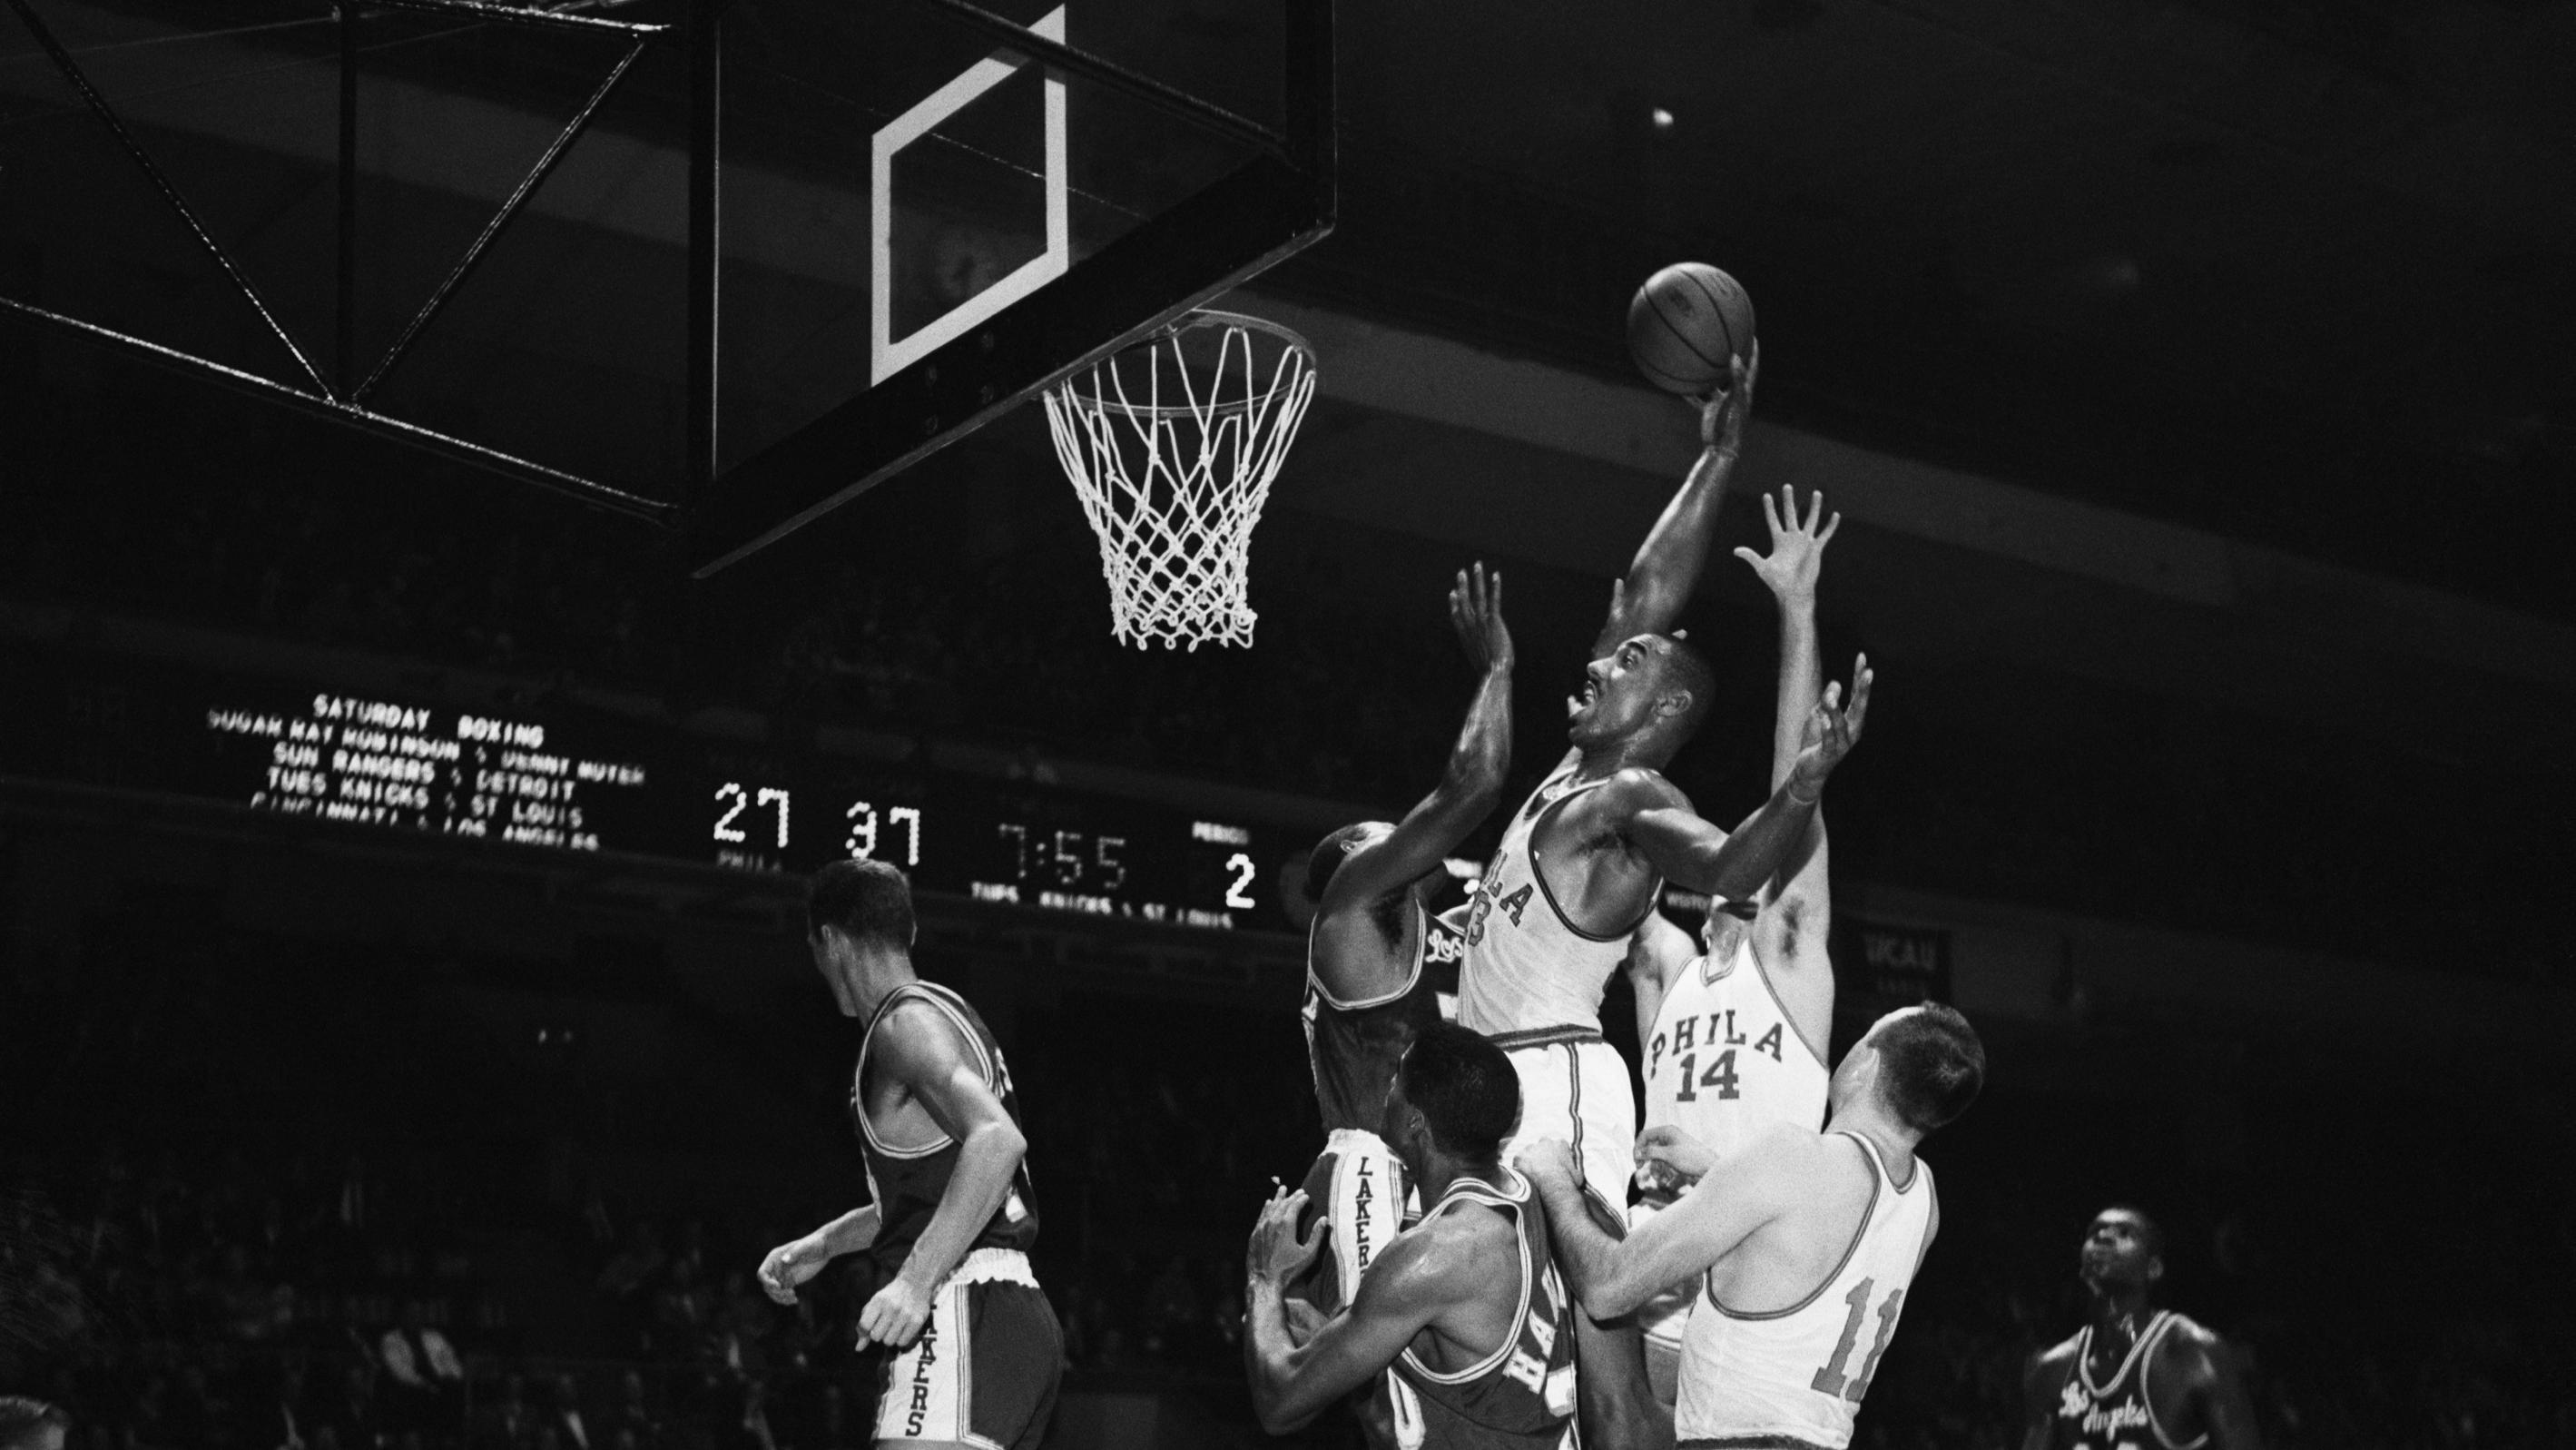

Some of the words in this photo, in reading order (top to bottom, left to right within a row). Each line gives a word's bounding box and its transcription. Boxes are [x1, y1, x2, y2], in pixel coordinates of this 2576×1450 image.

[313, 693, 430, 733] SATURDAY
[457, 714, 545, 750] BOXING
[267, 764, 327, 797] TUES
[339, 776, 429, 811] KNICKS
[470, 793, 498, 819] ST
[512, 799, 583, 830] LOUIS
[273, 740, 320, 770] SUN
[332, 748, 435, 785] RANGERS
[476, 768, 575, 804] DETROIT
[713, 782, 789, 849] 27
[845, 801, 920, 867] 37
[998, 823, 1126, 891] 7:55
[1225, 853, 1256, 909] 2
[1650, 1009, 1784, 1080] PHILA
[1676, 1050, 1740, 1102] 14
[1355, 1157, 1373, 1274] LAKER
[1811, 1277, 1903, 1404] 11
